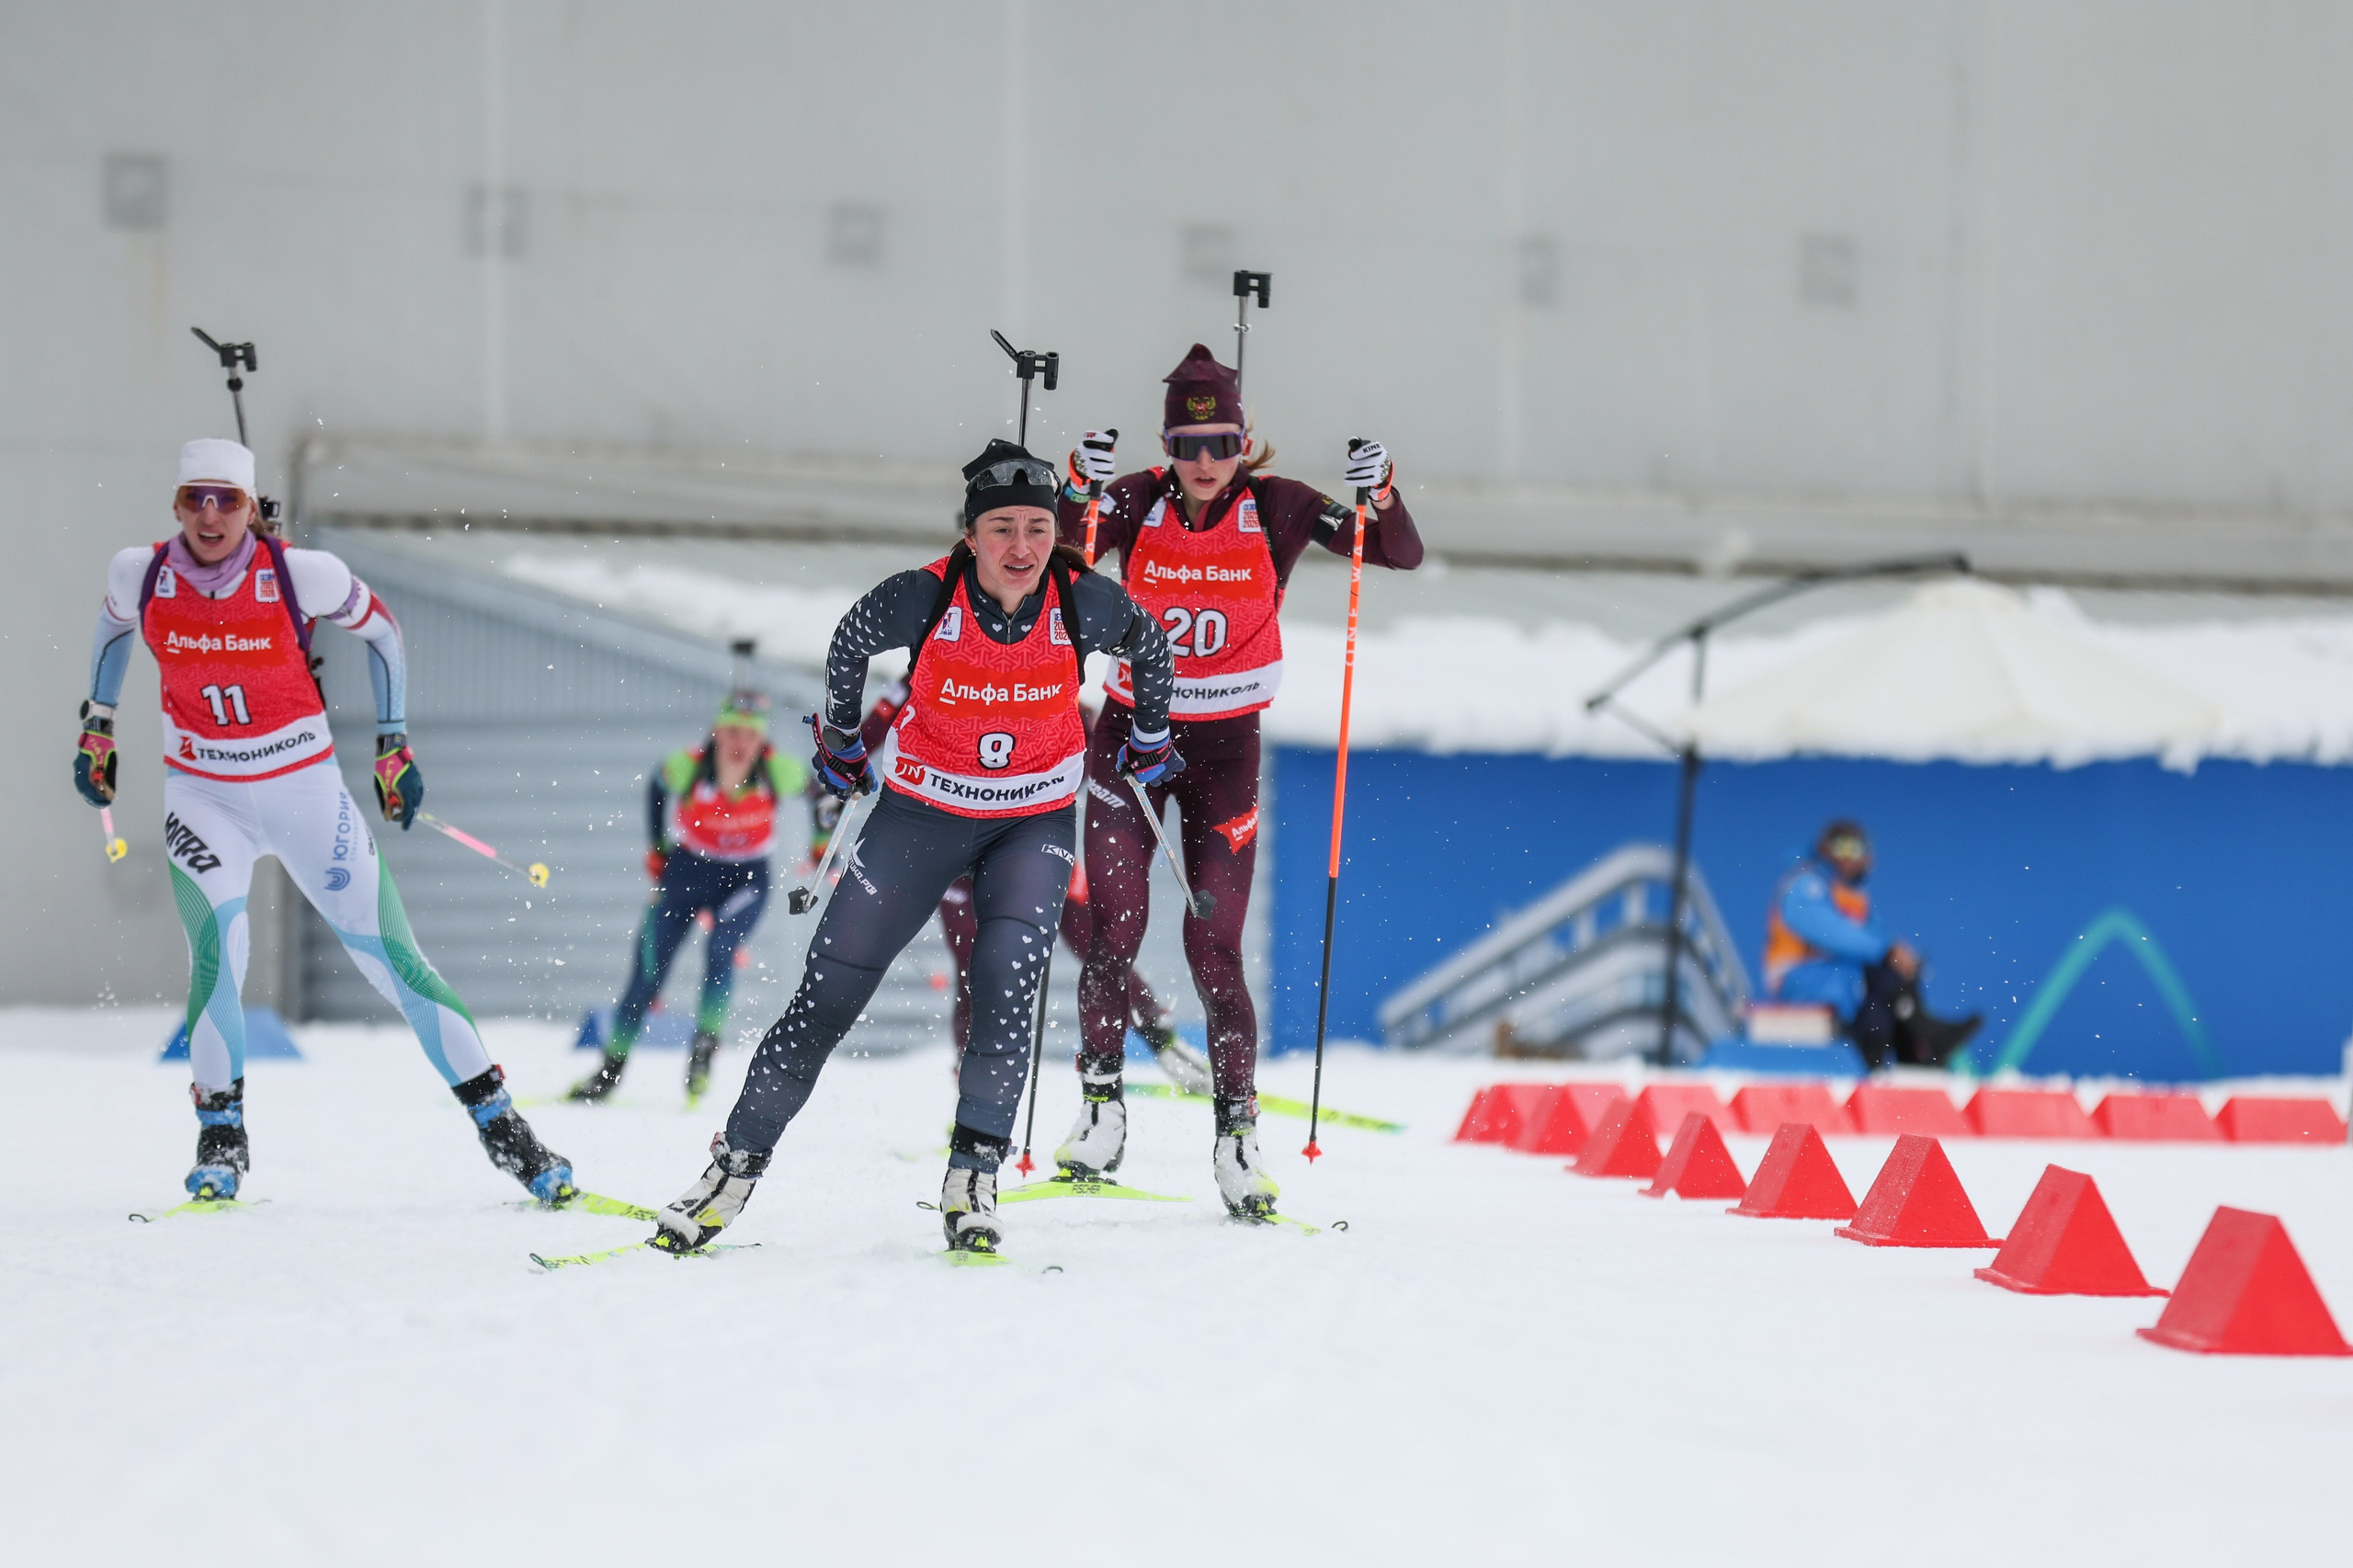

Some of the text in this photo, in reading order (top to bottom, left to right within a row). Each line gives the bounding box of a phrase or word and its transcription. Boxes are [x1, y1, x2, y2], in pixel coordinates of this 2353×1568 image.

[1143, 560, 1252, 584] Альфа Банк
[166, 631, 272, 654] Альфа Банк
[1054, 631, 1070, 641] 202
[1163, 607, 1227, 658] 20
[939, 678, 1063, 705] Альфа Банк
[1172, 682, 1260, 699] НОНИКОЛЬ
[200, 684, 252, 726] 11
[197, 732, 315, 762] ТЕХНОНИКОЛЬ
[1072, 1184, 1101, 1195] FISCHER
